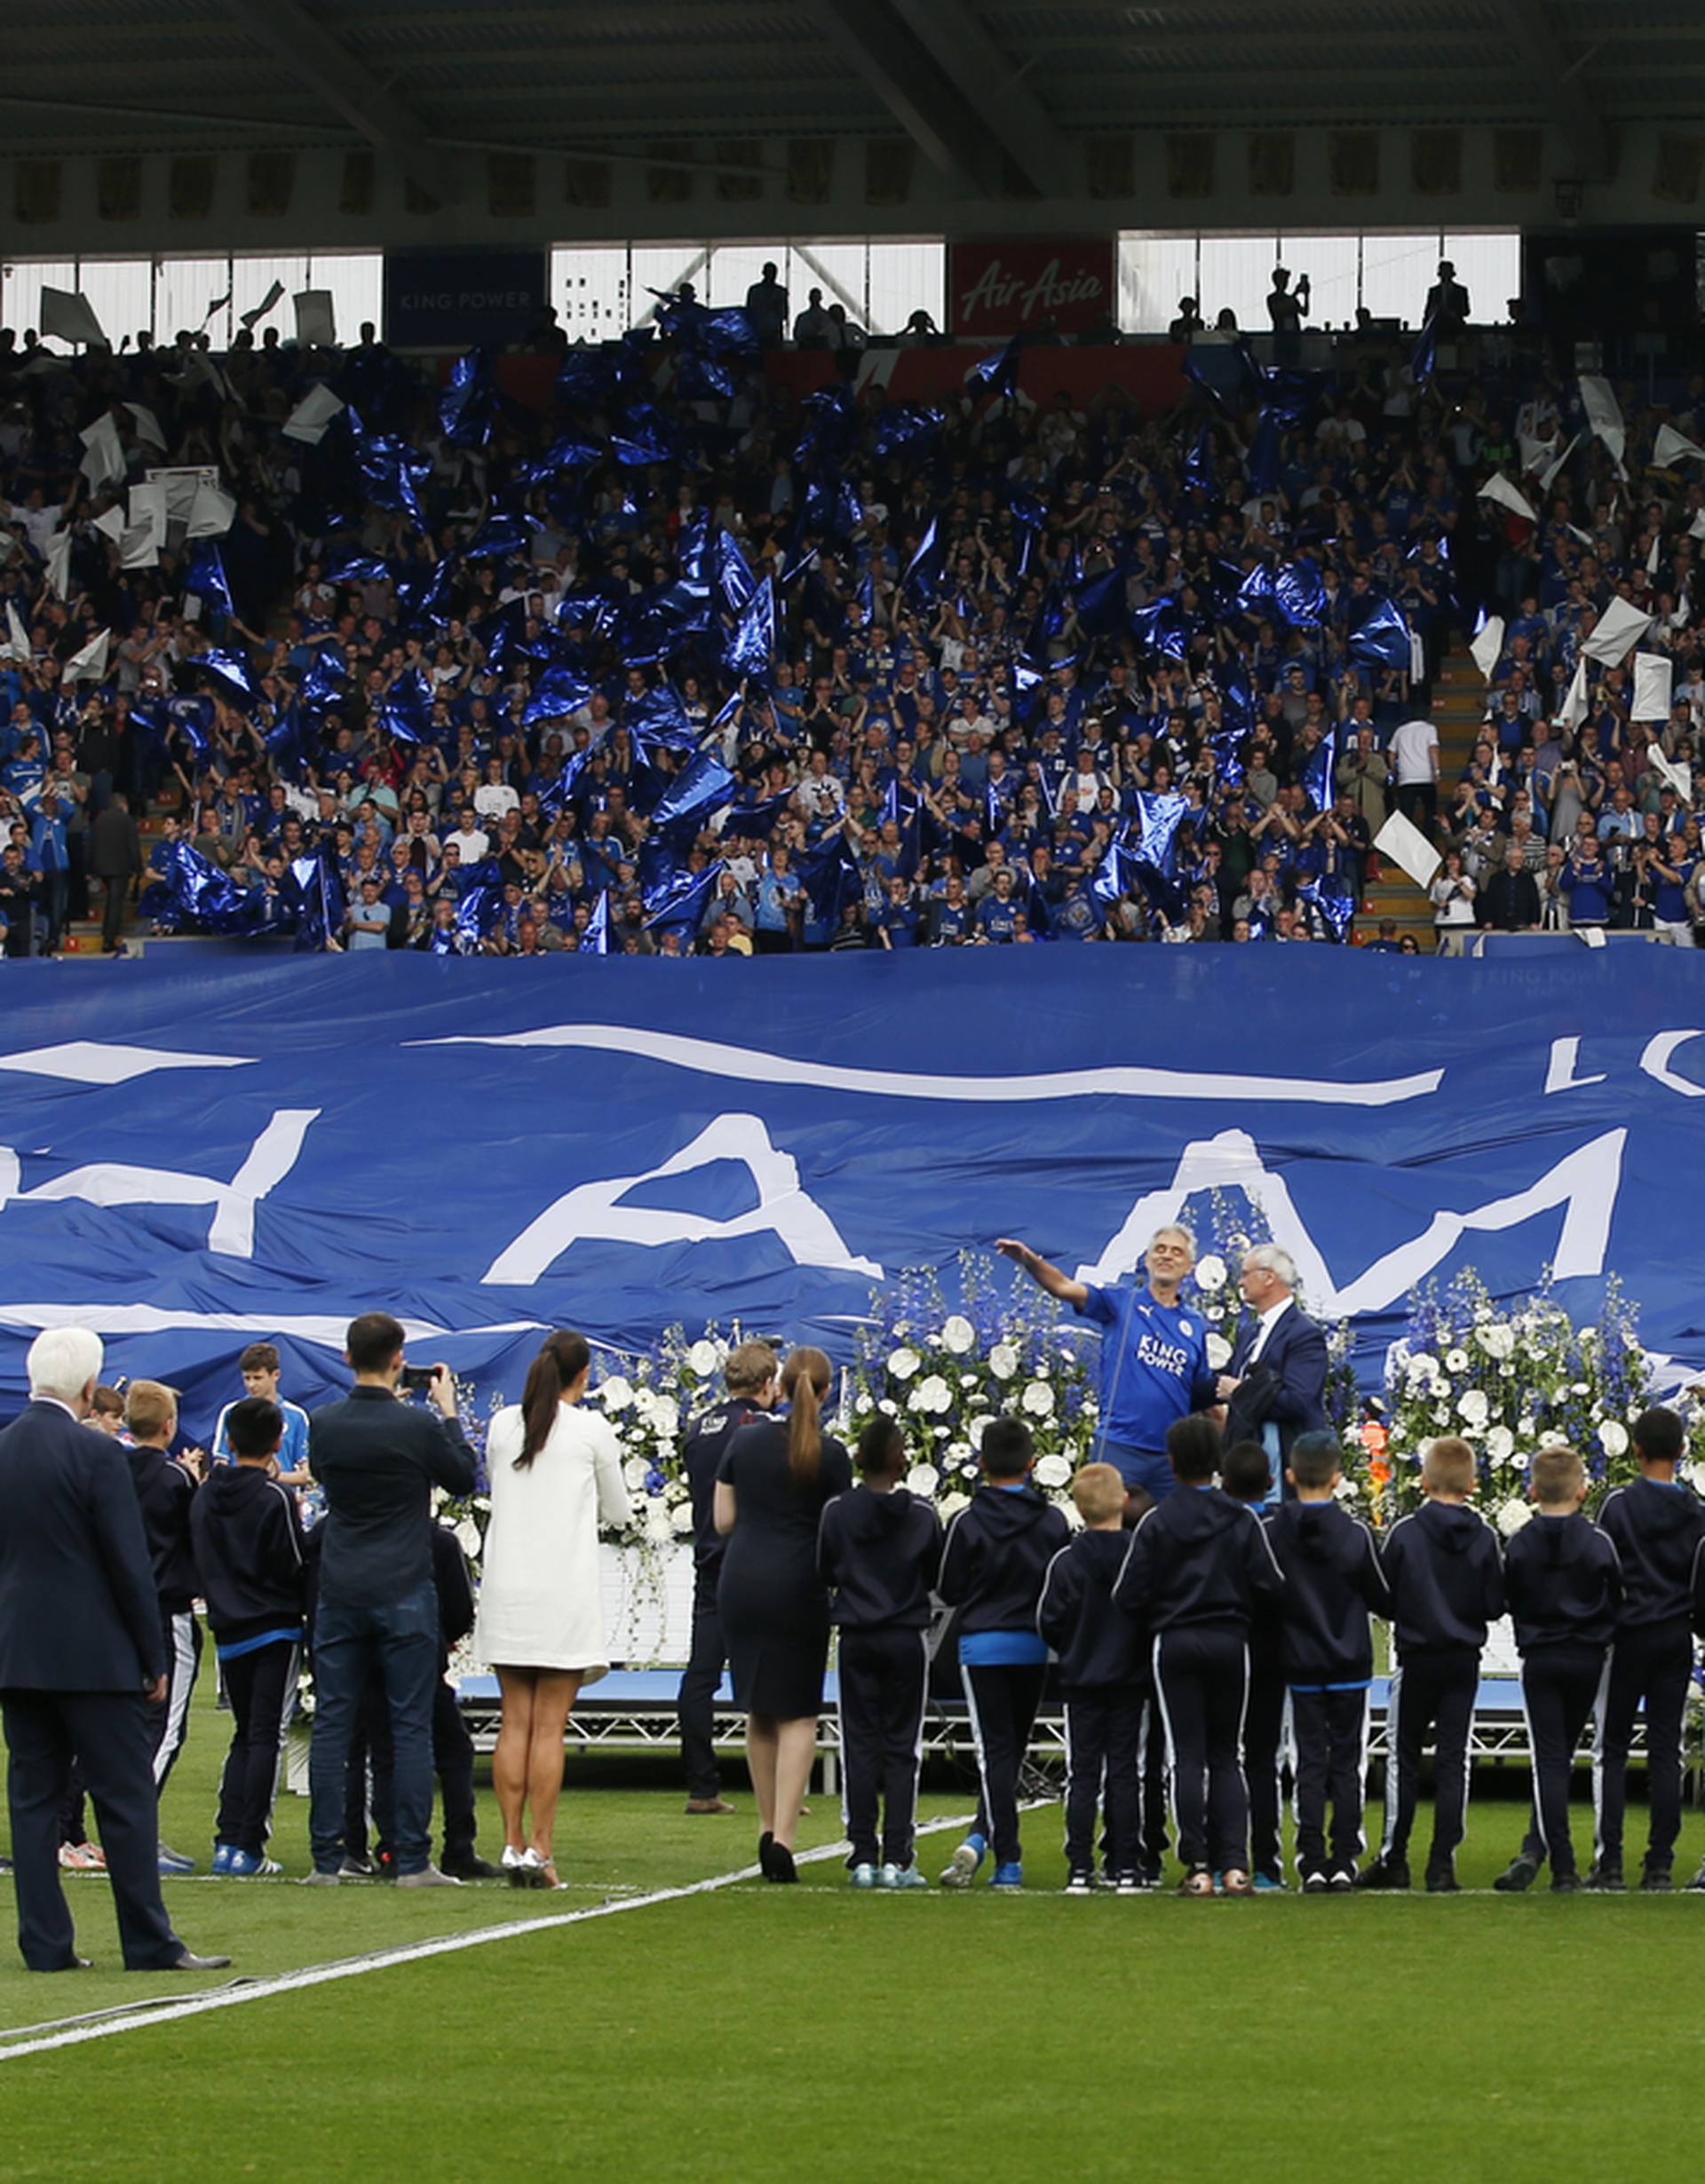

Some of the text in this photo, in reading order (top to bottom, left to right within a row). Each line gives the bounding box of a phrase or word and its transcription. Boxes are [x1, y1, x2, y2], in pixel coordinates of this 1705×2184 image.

[400, 291, 532, 312] KING POWER
[1138, 1334, 1187, 1365] KING
[1138, 1350, 1185, 1377] POWER
